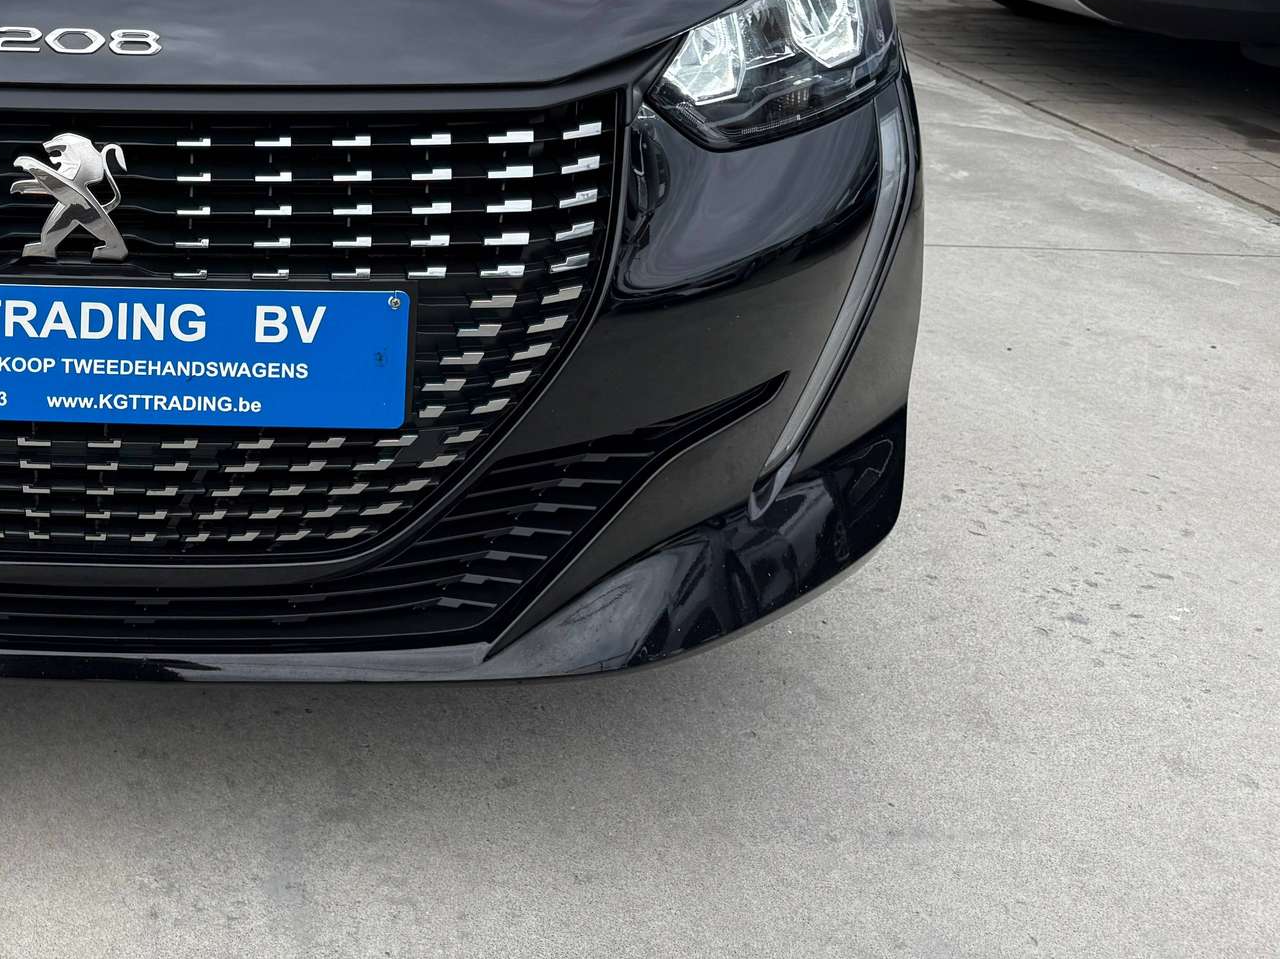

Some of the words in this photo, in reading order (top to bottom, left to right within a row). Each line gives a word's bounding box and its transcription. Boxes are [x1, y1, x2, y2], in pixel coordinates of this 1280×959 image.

[254, 305, 327, 344] BV
[61, 358, 309, 379] TWEEDEHANDSWAGENS
[46, 393, 262, 413] www.KGTTRADING.be
